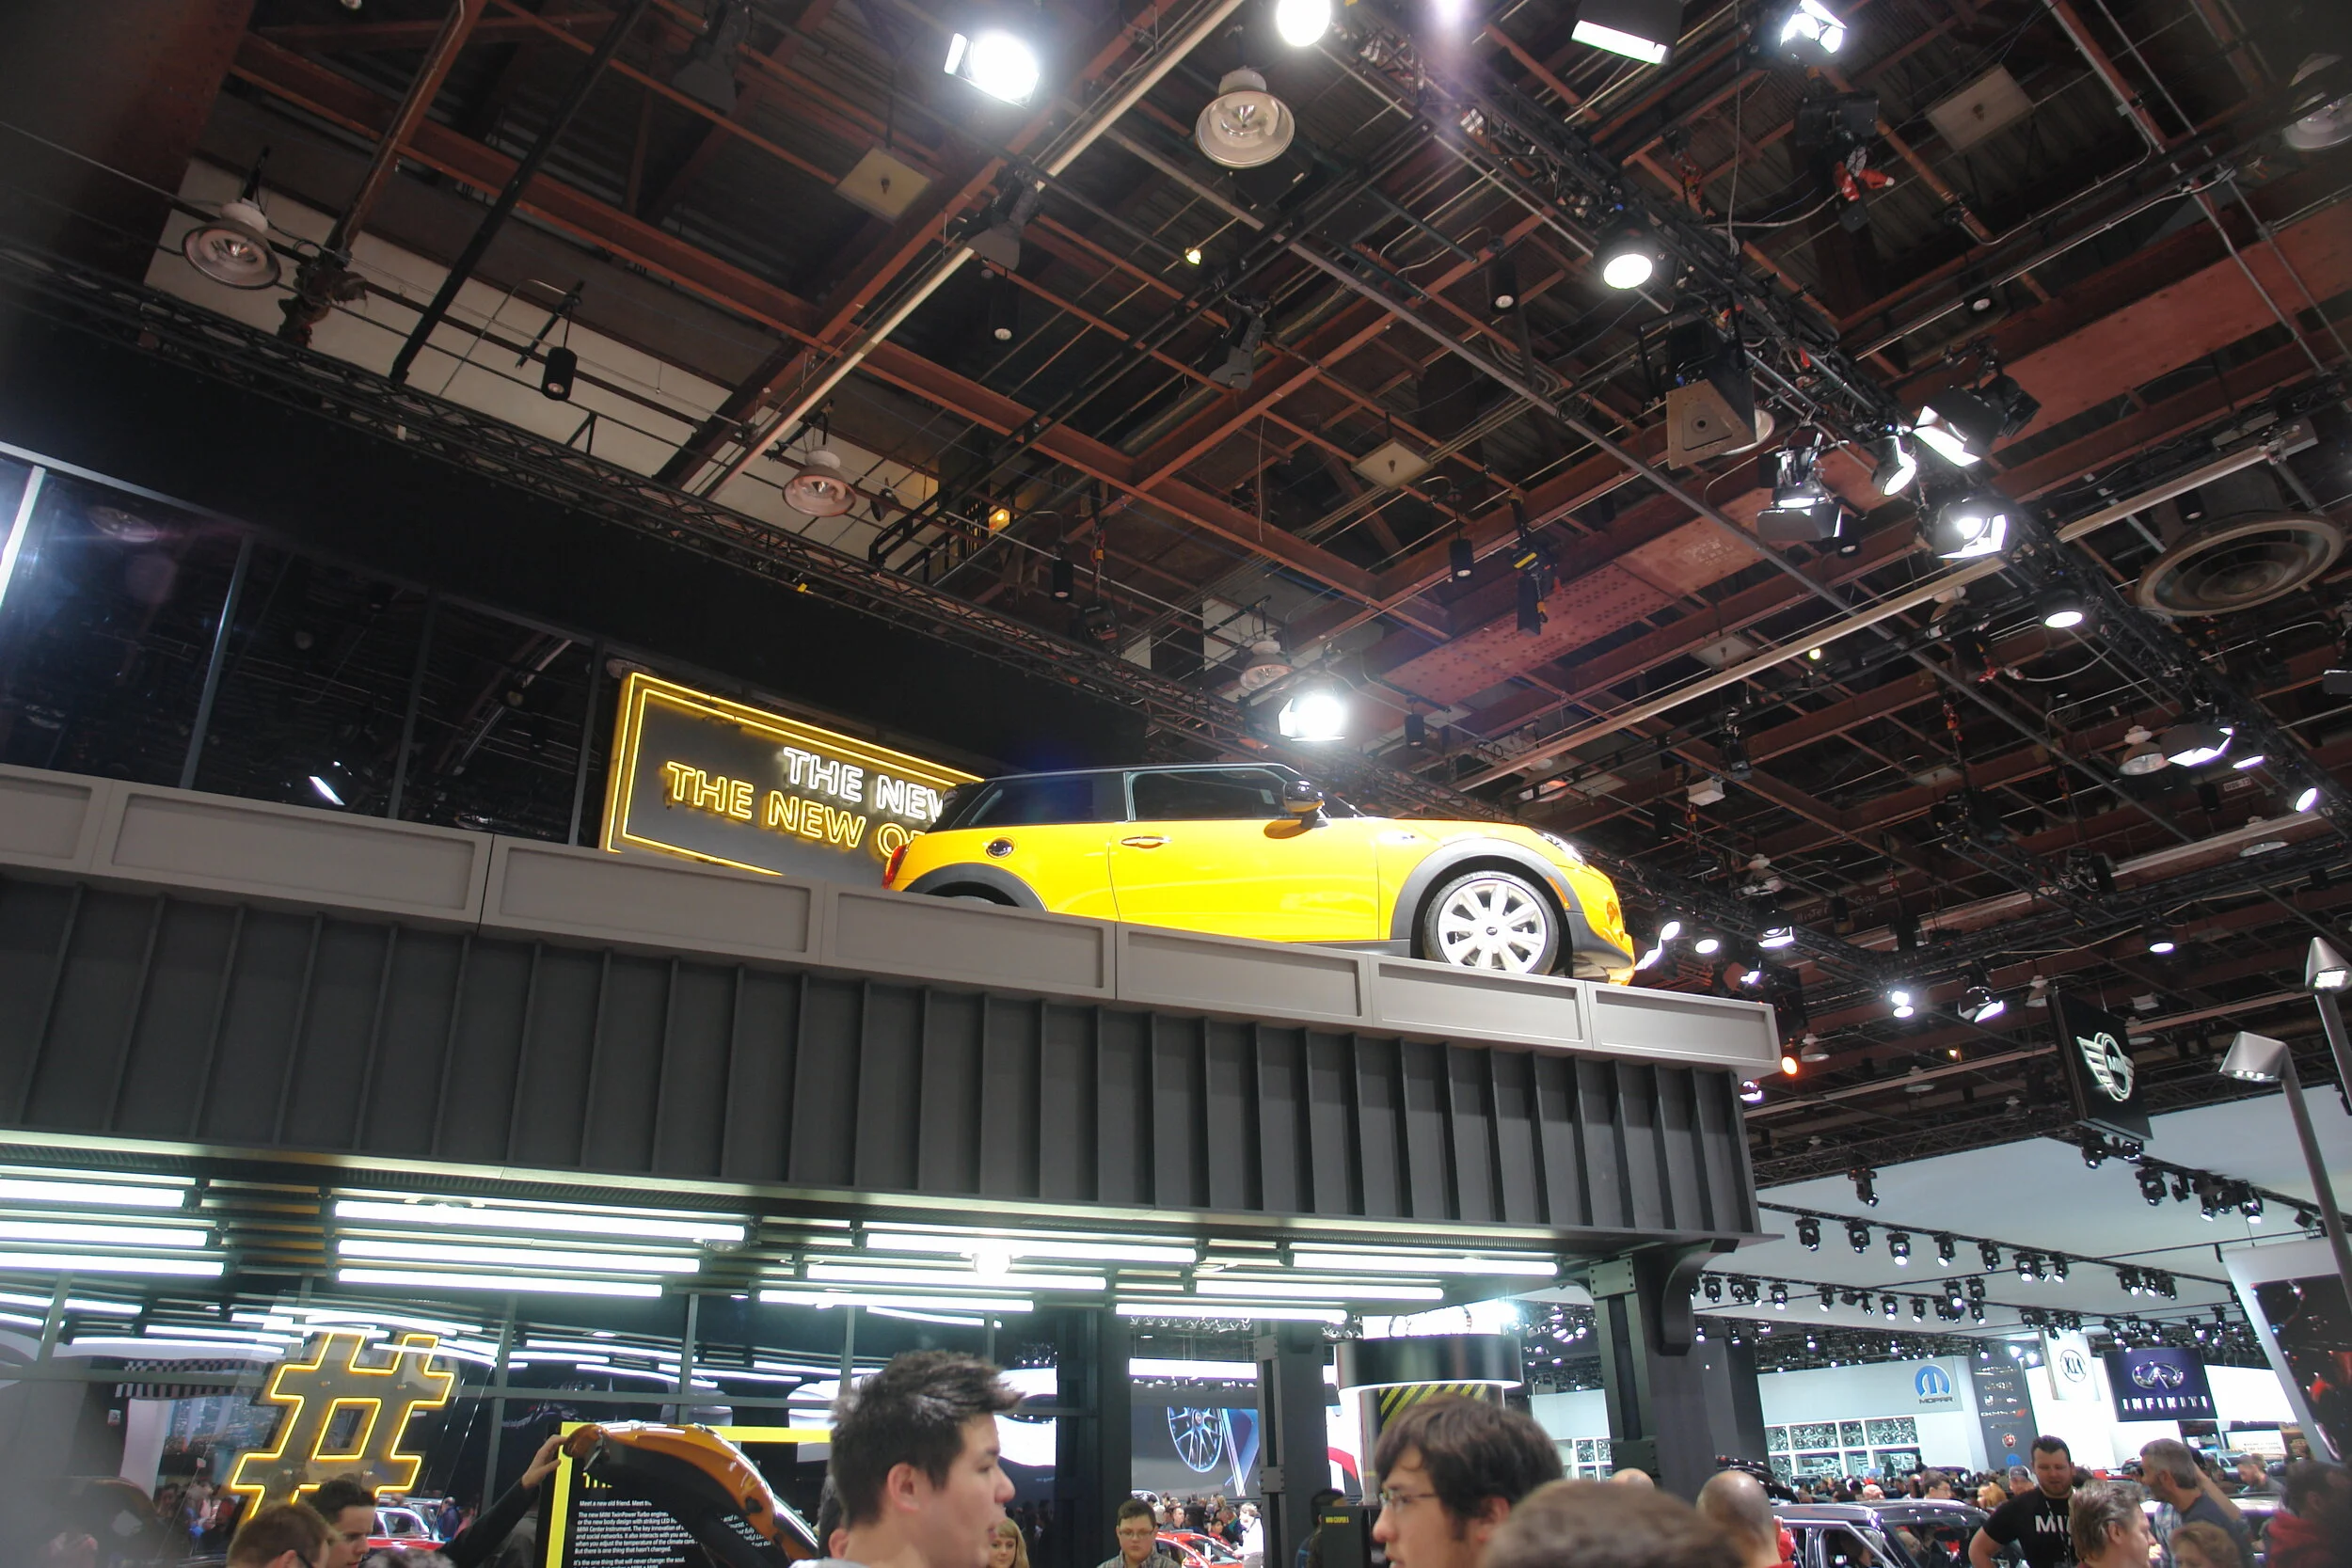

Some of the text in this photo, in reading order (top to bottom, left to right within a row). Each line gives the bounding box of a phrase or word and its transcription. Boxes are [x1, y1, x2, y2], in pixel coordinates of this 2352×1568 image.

[784, 746, 864, 803] THE
[666, 760, 926, 858] THE NEW O
[1918, 1396, 1954, 1404] MOPAR
[2122, 1395, 2209, 1411] INFINITI
